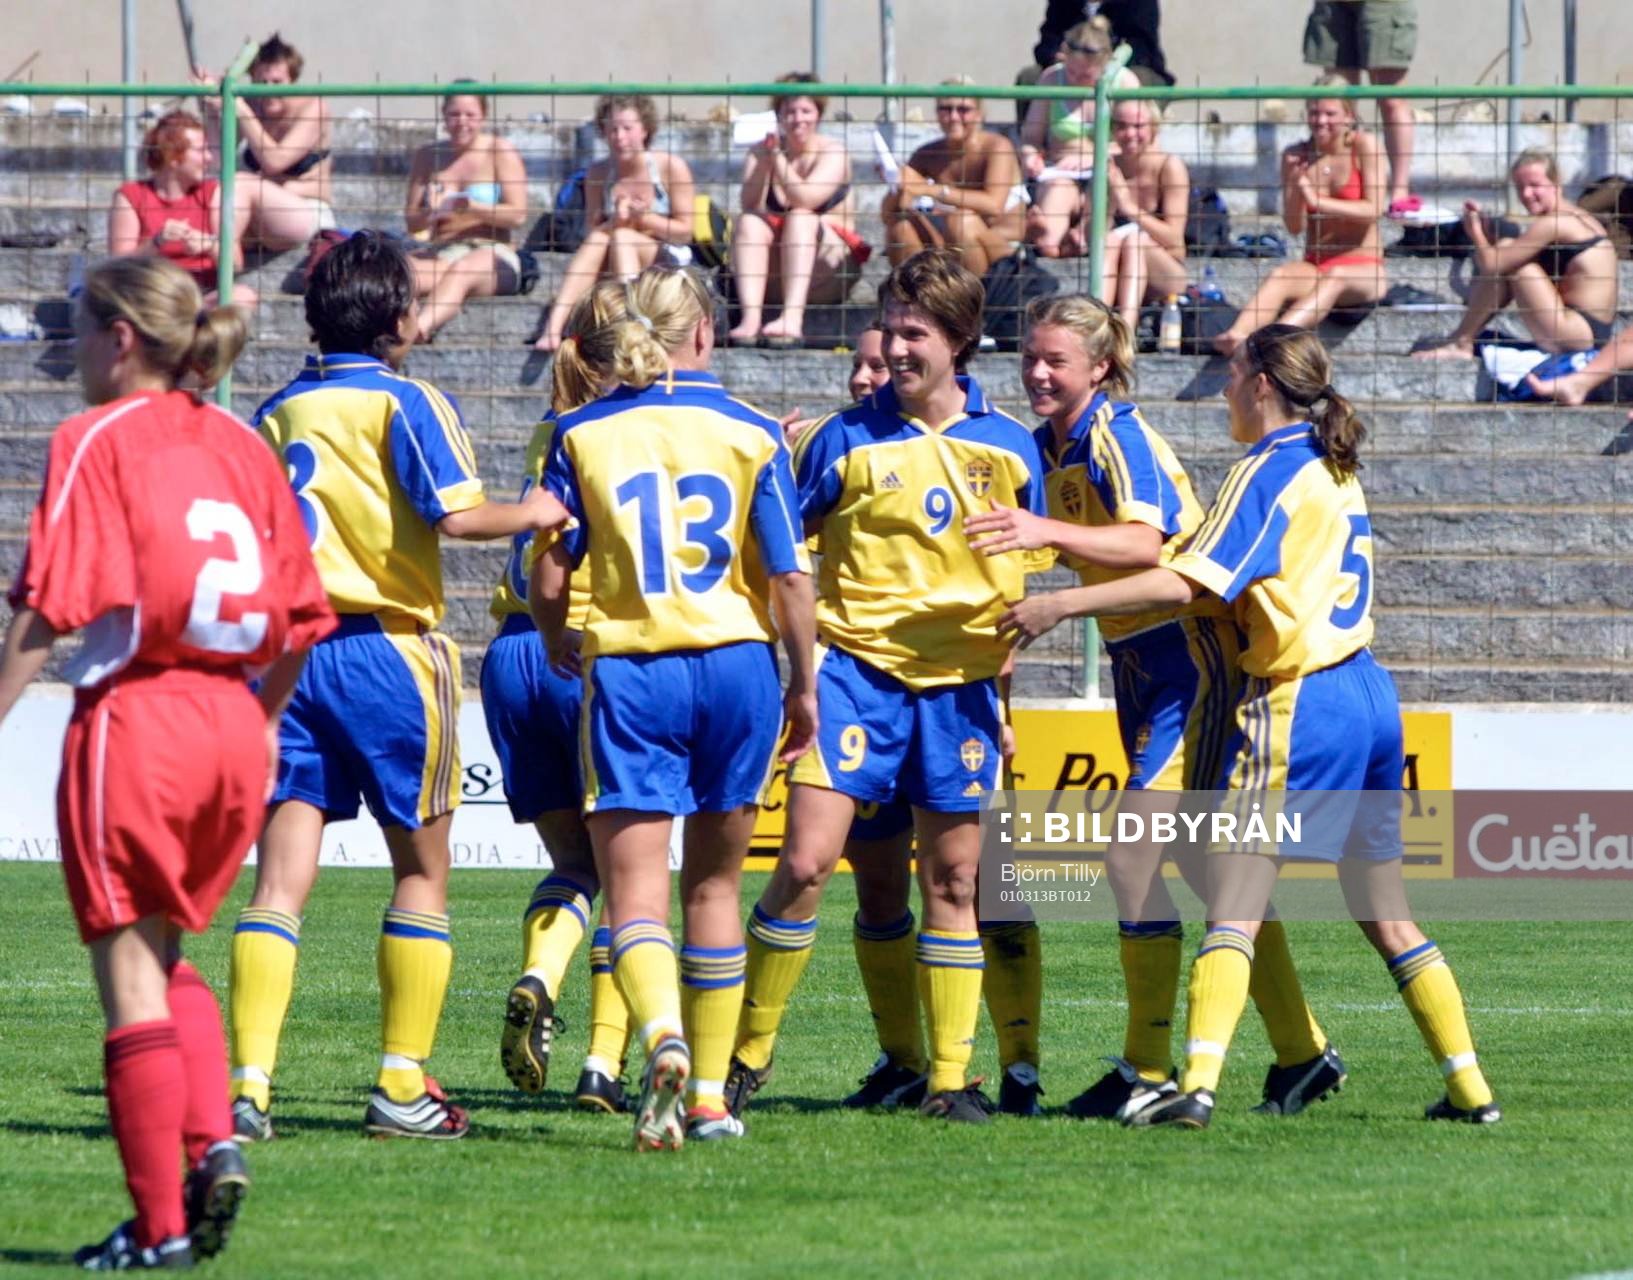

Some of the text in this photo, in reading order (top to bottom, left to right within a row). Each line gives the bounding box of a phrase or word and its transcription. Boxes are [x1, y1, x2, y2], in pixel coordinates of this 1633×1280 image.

[615, 471, 733, 594] 13
[924, 486, 954, 536] 9
[180, 497, 269, 654] 2
[1328, 513, 1370, 630] 5
[838, 724, 868, 773] 9
